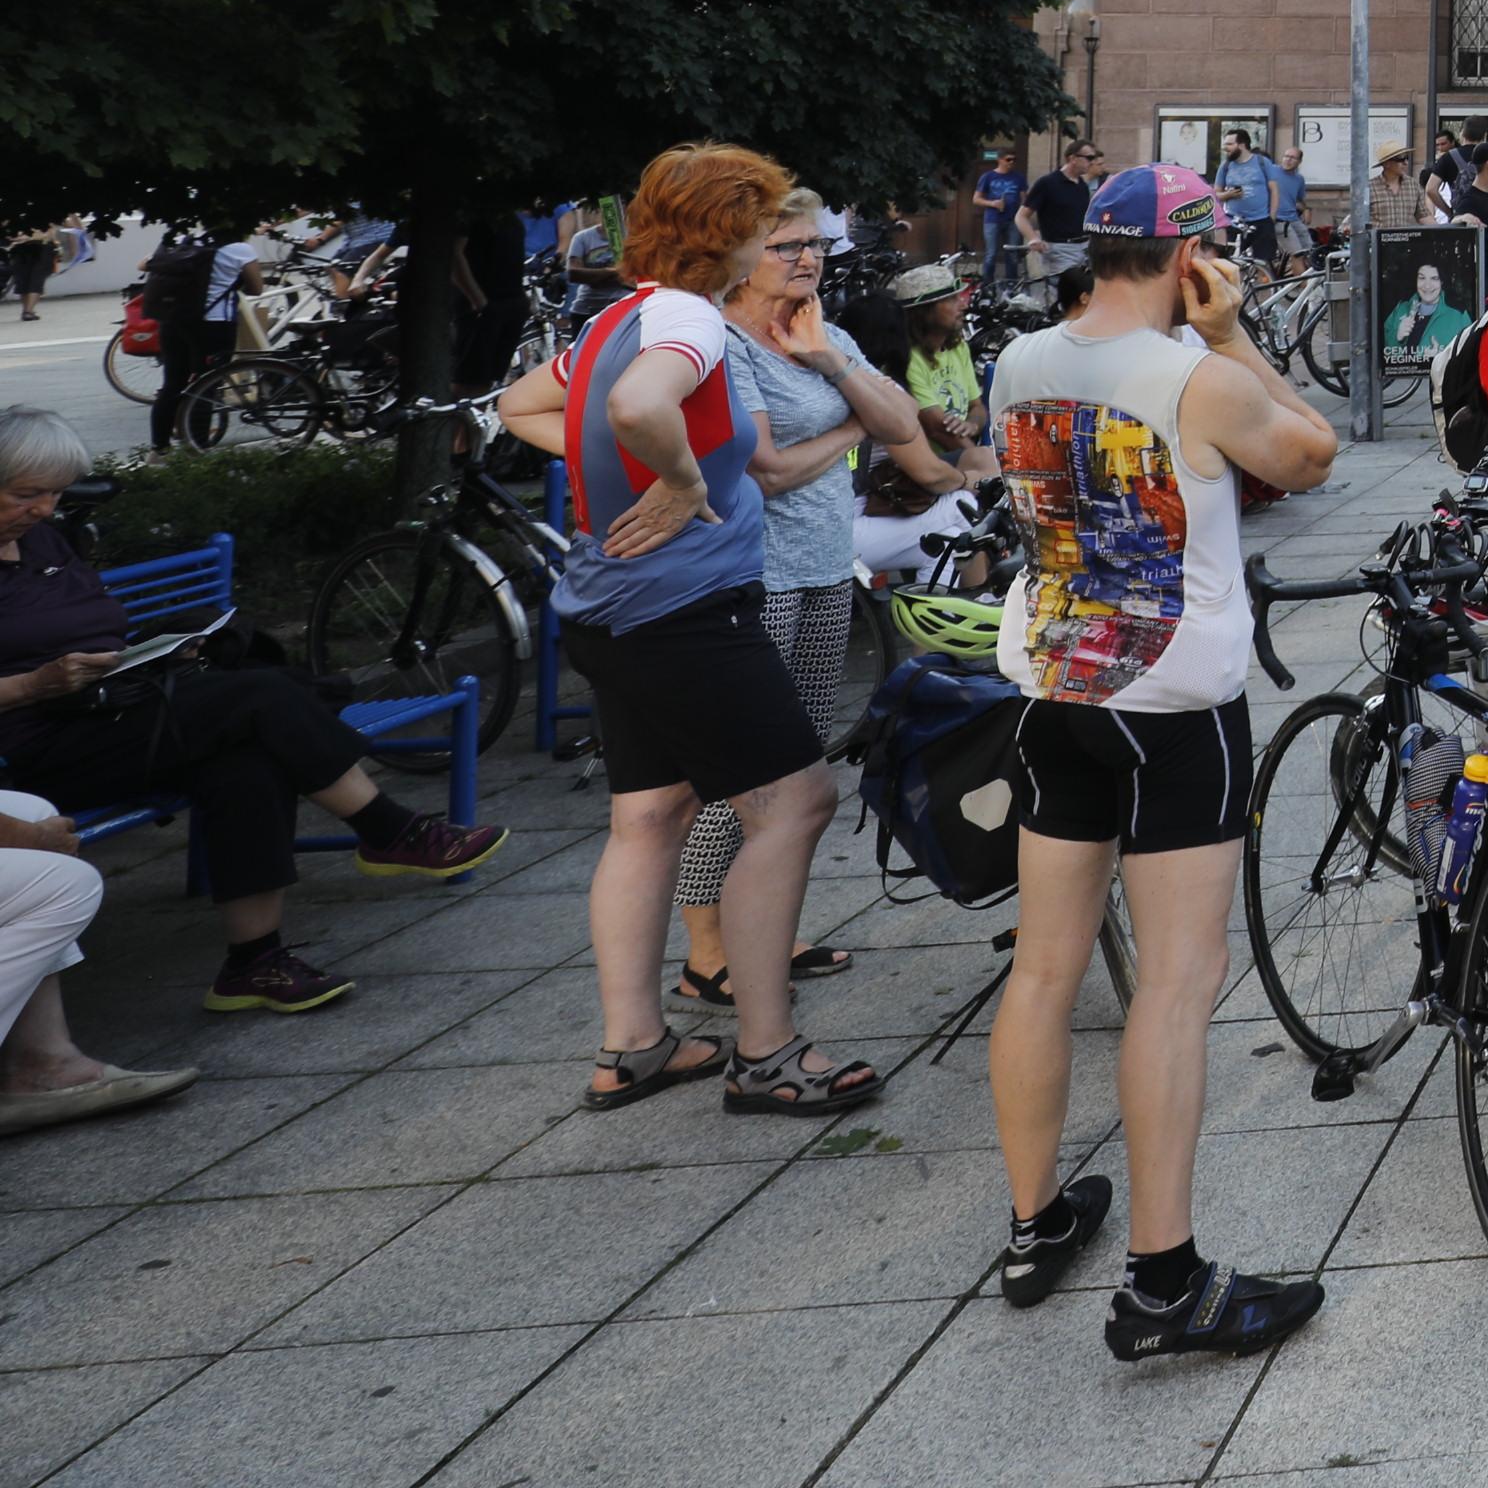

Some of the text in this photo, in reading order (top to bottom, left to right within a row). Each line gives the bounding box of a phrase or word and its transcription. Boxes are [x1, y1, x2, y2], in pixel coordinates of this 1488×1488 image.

[1302, 121, 1323, 143] B
[1383, 346, 1408, 356] CEM
[1384, 354, 1430, 364] YEGINER
[1072, 430, 1089, 497] triathlon
[1134, 1335, 1163, 1351] LAKE
